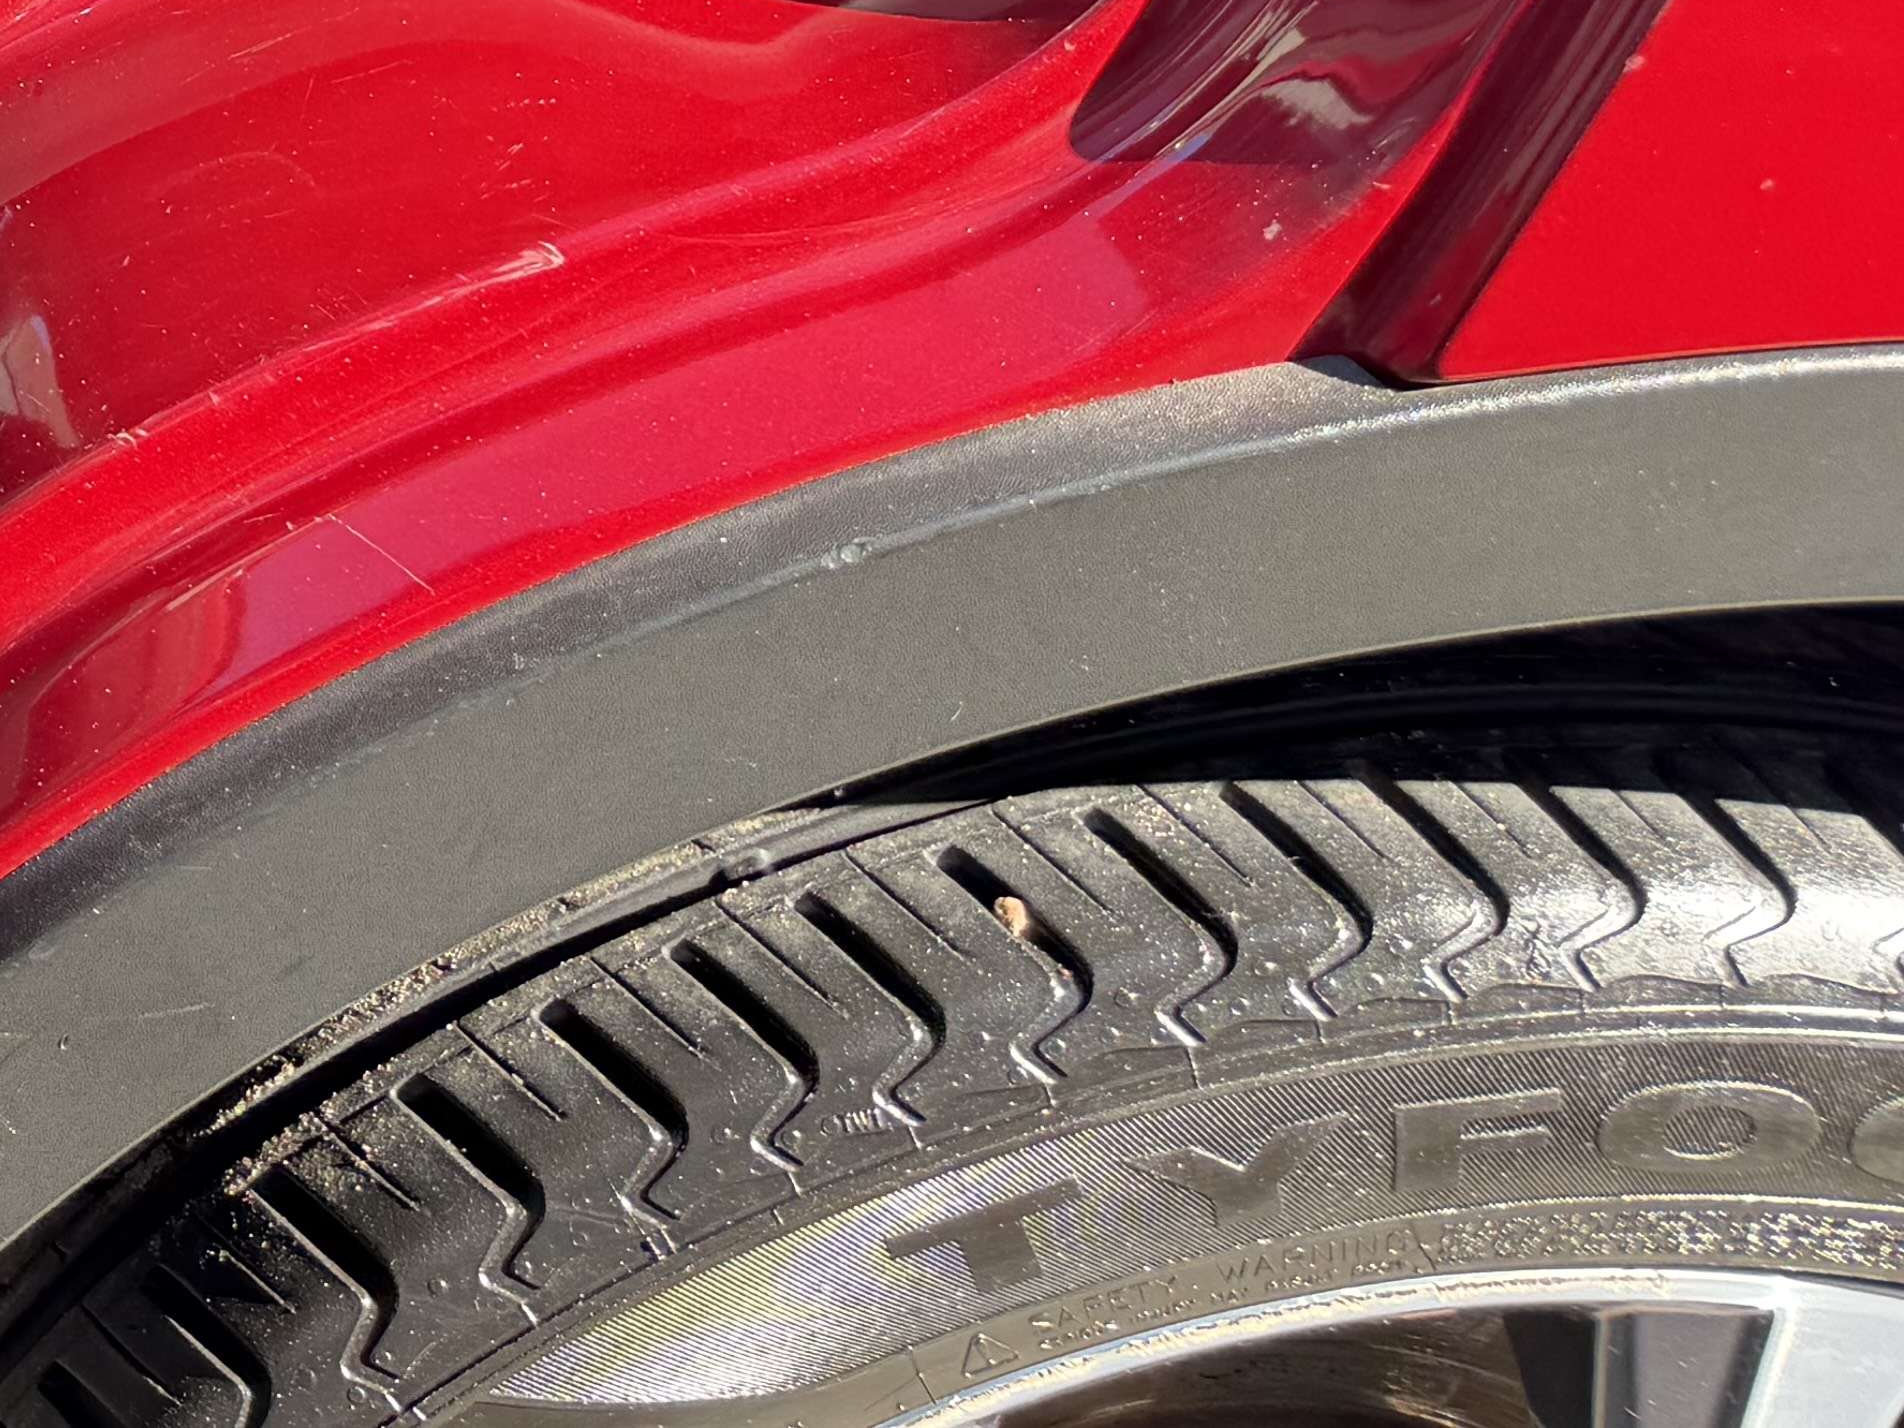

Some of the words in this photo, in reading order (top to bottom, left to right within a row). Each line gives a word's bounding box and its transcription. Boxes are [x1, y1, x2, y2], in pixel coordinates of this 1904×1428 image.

[884, 1080, 1904, 1294] TYFO
[1029, 1276, 1177, 1330] SAFETY
[1216, 1231, 1409, 1282] WARNING
